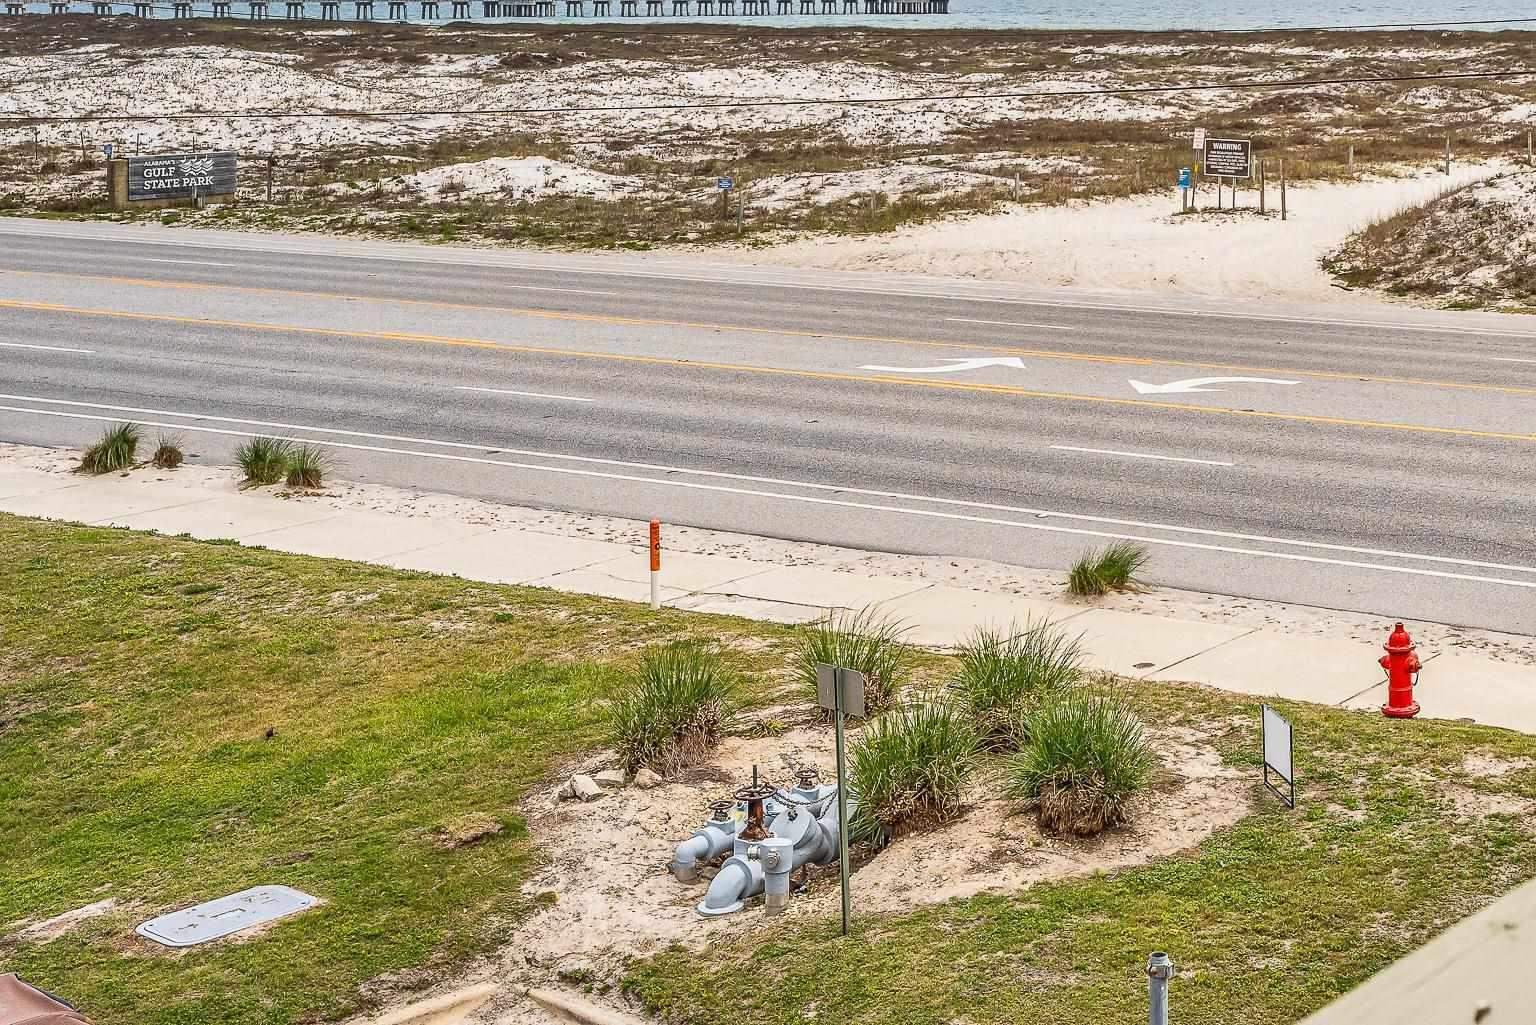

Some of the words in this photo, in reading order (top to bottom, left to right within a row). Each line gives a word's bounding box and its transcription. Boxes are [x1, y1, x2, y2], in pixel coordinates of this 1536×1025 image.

[143, 167, 176, 178] GULF
[143, 178, 180, 190] STATE
[182, 176, 214, 187] PARK
